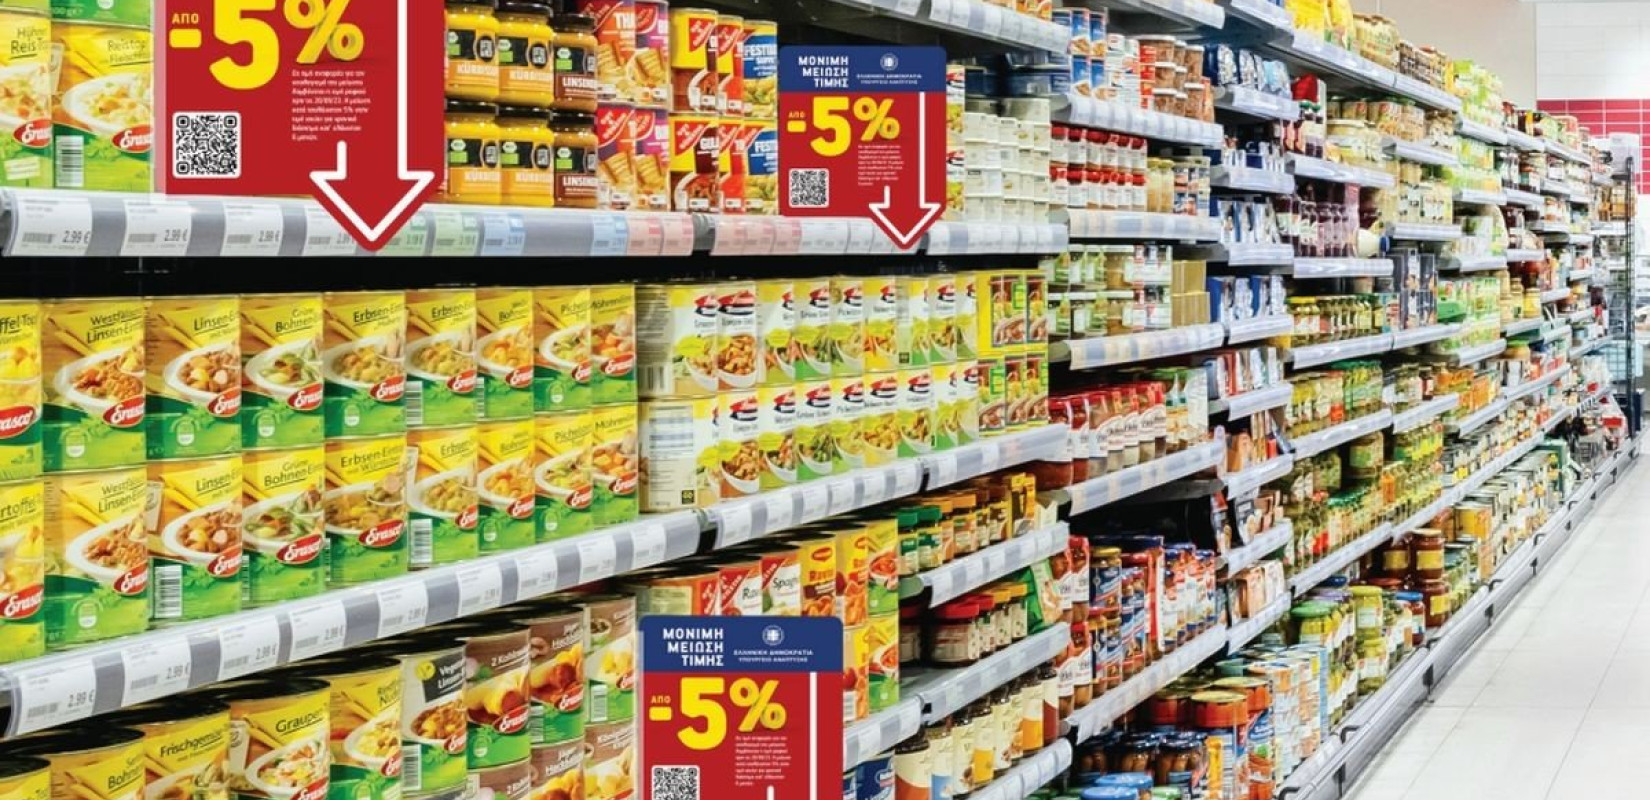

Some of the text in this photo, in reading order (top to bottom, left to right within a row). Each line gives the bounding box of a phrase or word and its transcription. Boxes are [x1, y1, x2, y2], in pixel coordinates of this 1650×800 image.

[172, 13, 199, 24] ΑΠΟ
[169, 0, 364, 90] -5%
[798, 55, 849, 66] ΜΟΝΙΜΗ
[802, 67, 849, 77] ΜΕΙΩΣΗ
[813, 78, 849, 88] ΤΙΜΗΣ
[788, 110, 806, 119] ΑΠΟ
[787, 96, 900, 155] -5%
[663, 628, 724, 639] ΜΟΝΙΜΗ
[667, 641, 724, 653] ΜΕΙΩΣΗ
[682, 655, 724, 666] ΤΙΜΗΣ
[651, 695, 671, 704] ΑΠΟ
[649, 677, 787, 750] -5%
